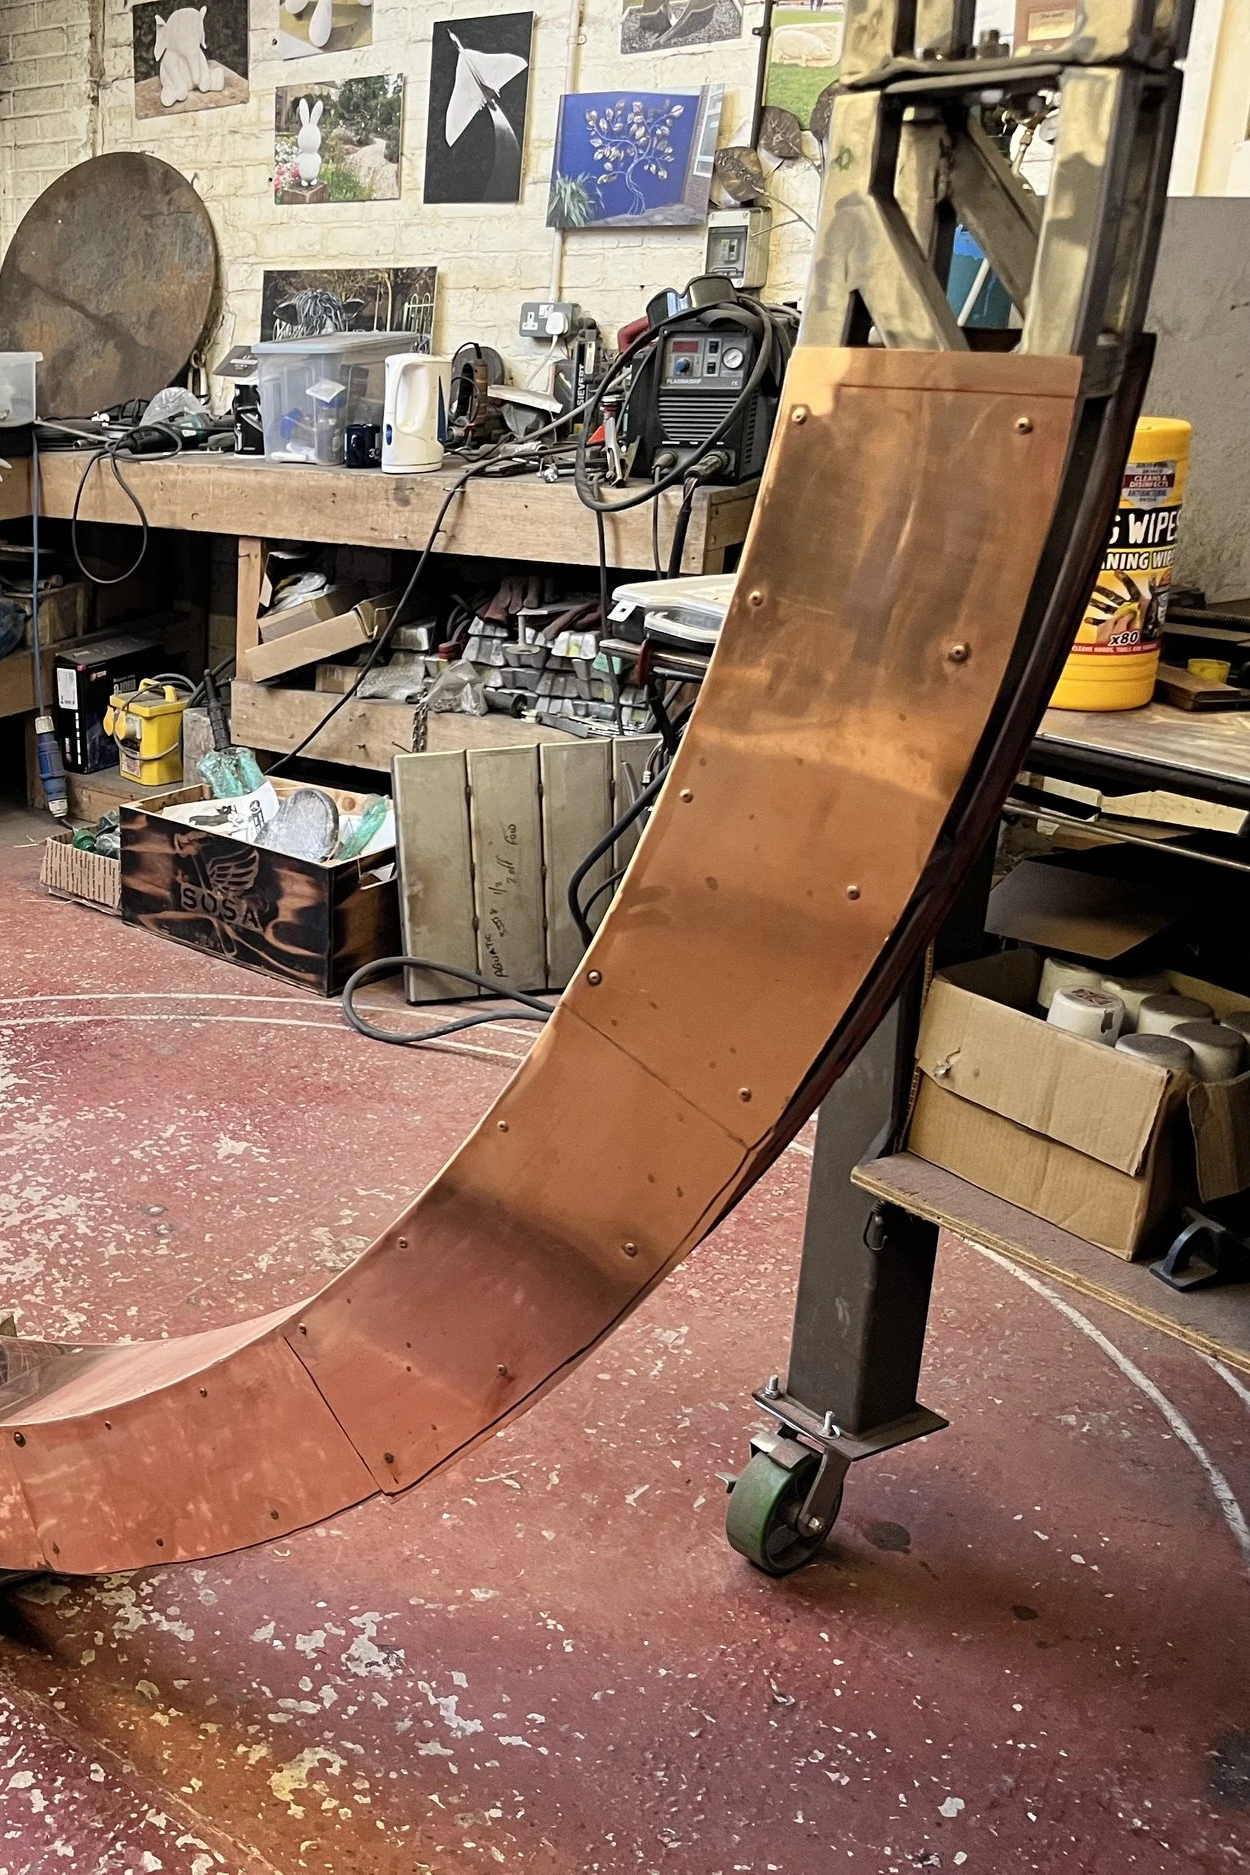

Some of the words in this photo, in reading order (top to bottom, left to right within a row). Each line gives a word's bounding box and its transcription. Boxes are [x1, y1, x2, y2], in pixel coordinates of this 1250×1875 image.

[576, 363, 586, 407] SIEVERT
[1109, 631, 1139, 646] x80
[182, 887, 260, 929] SOSA
